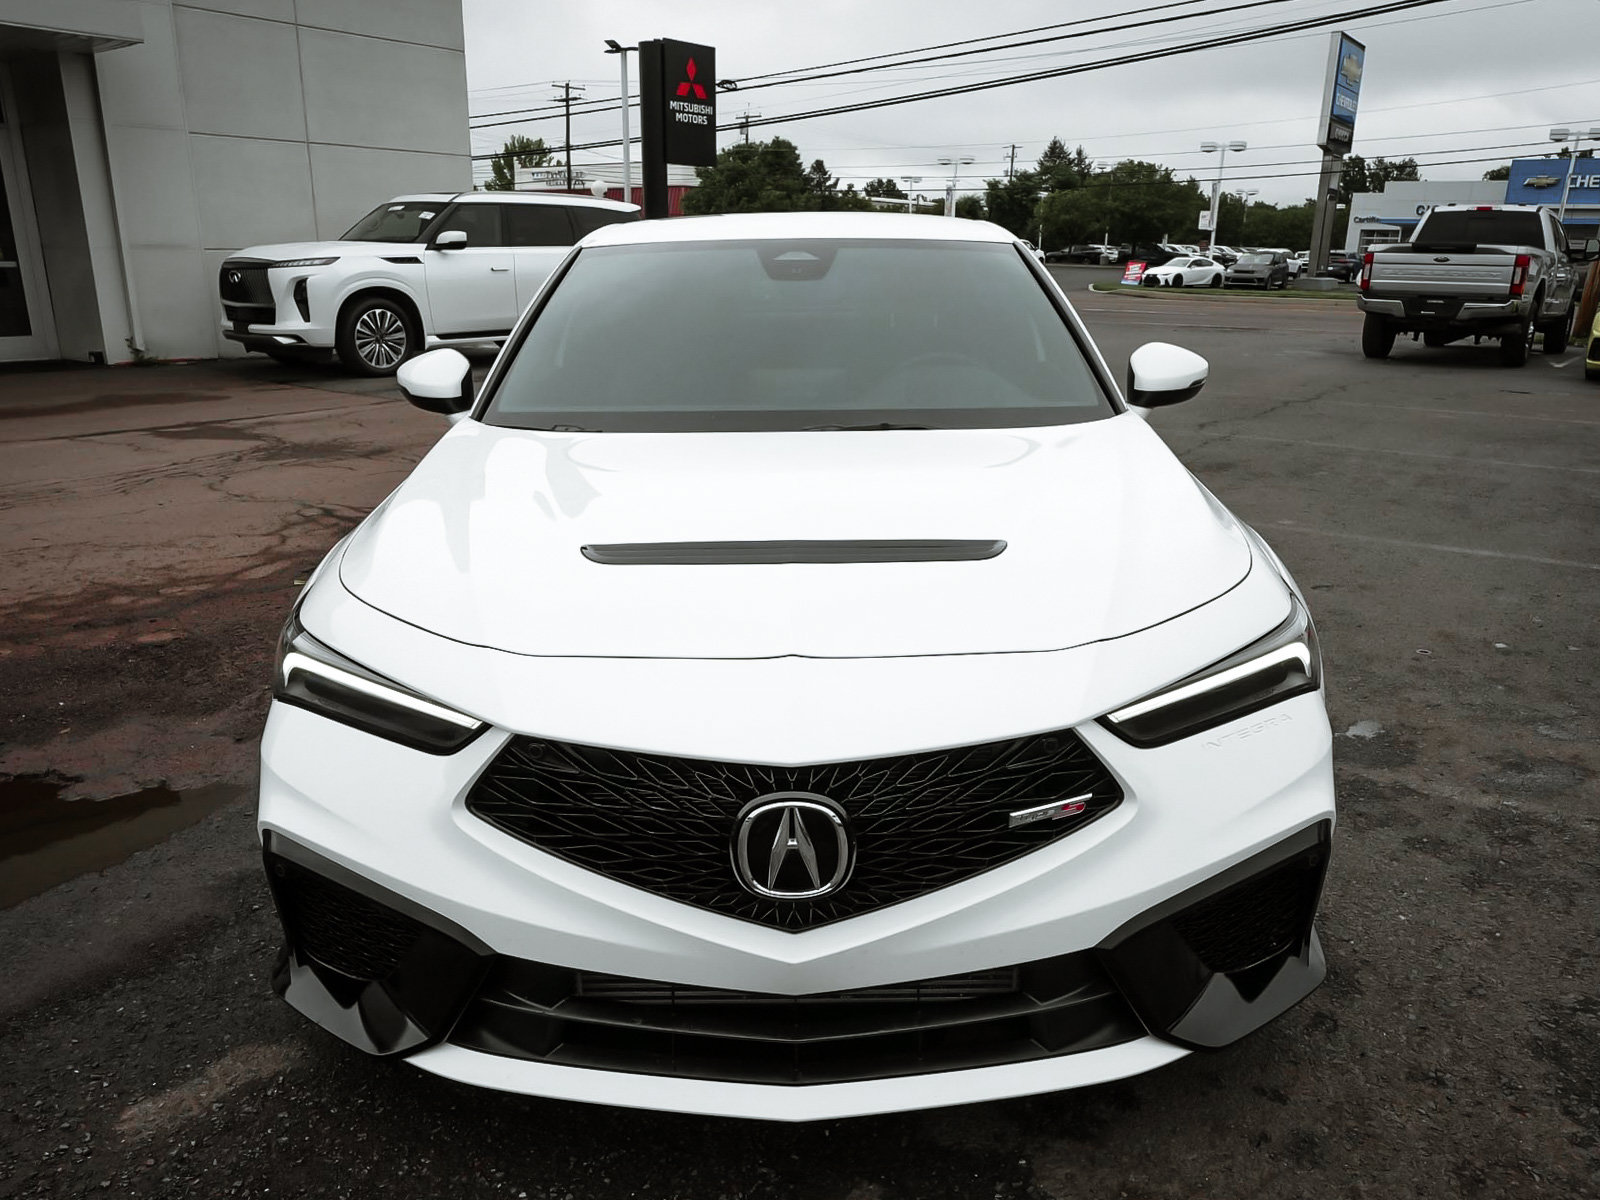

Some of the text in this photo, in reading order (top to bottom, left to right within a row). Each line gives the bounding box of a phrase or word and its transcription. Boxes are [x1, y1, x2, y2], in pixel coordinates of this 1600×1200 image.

[669, 100, 713, 115] MITSUBISHI
[675, 113, 708, 125] MOTORS
[1568, 174, 1600, 188] CHE
